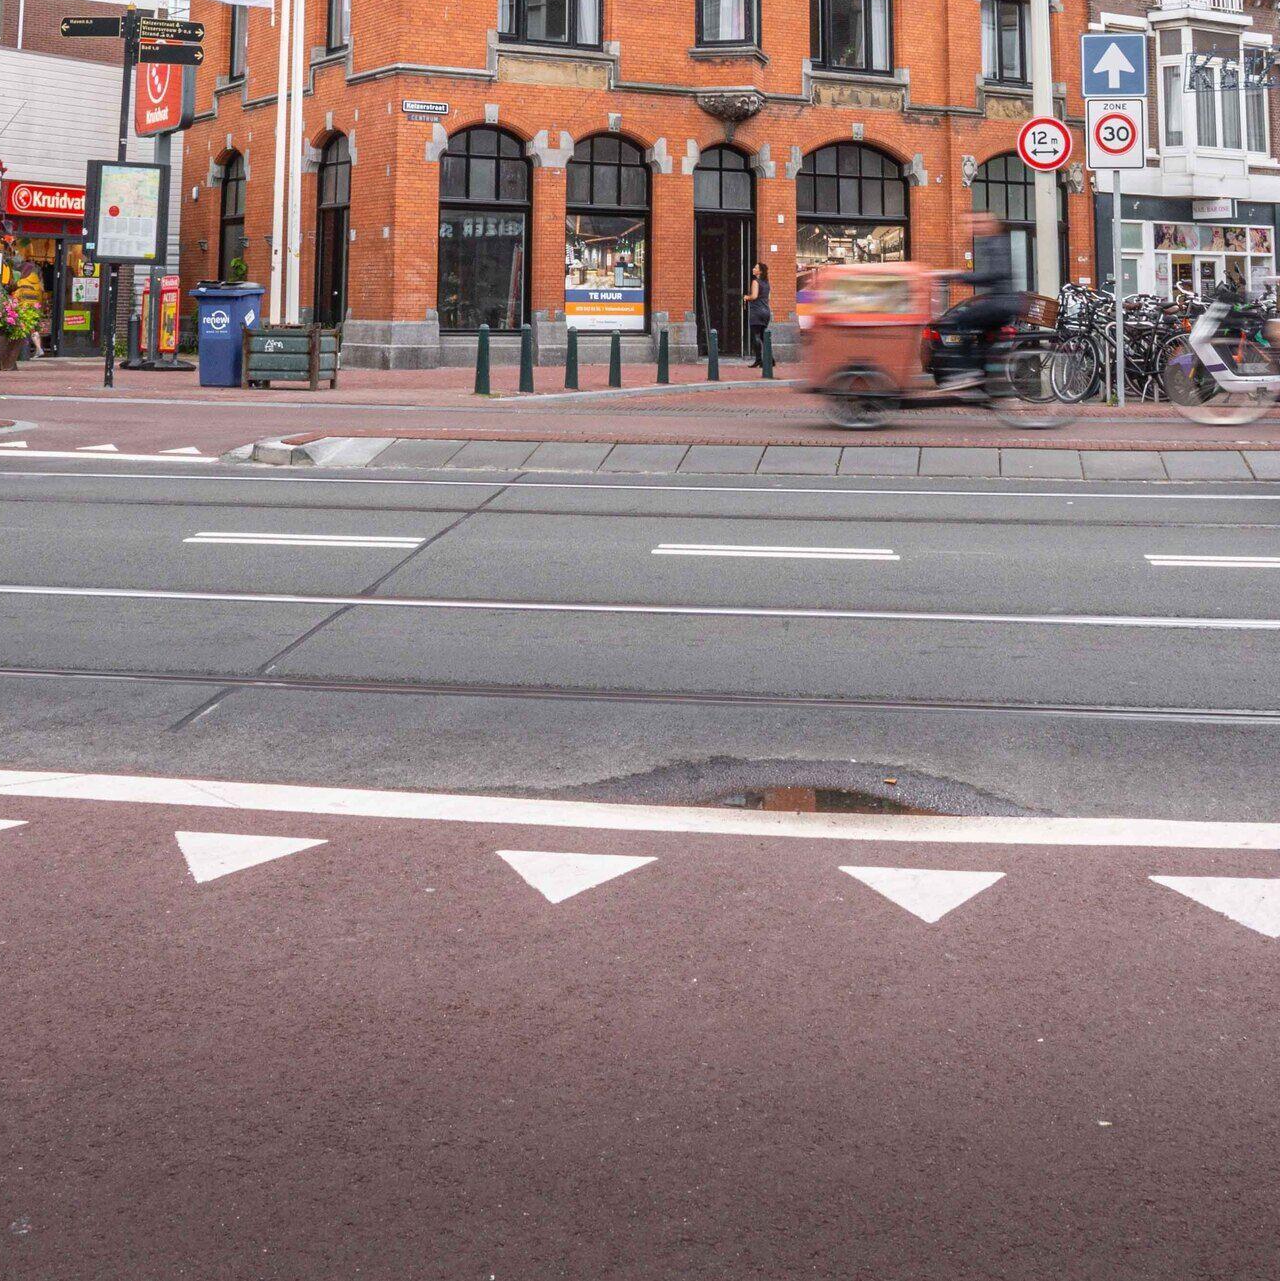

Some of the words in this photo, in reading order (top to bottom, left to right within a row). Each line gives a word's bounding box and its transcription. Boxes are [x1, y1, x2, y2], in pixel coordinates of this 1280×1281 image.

[142, 20, 175, 28] Keizerstraat
[406, 103, 445, 111] Keizerstraat
[1103, 103, 1128, 111] ZONE
[1103, 126, 1130, 141] 30
[1031, 131, 1048, 145] 12
[33, 191, 85, 211] Kruidvat
[588, 292, 599, 300] TE
[600, 292, 623, 300] HUUR
[203, 315, 230, 324] renewi
